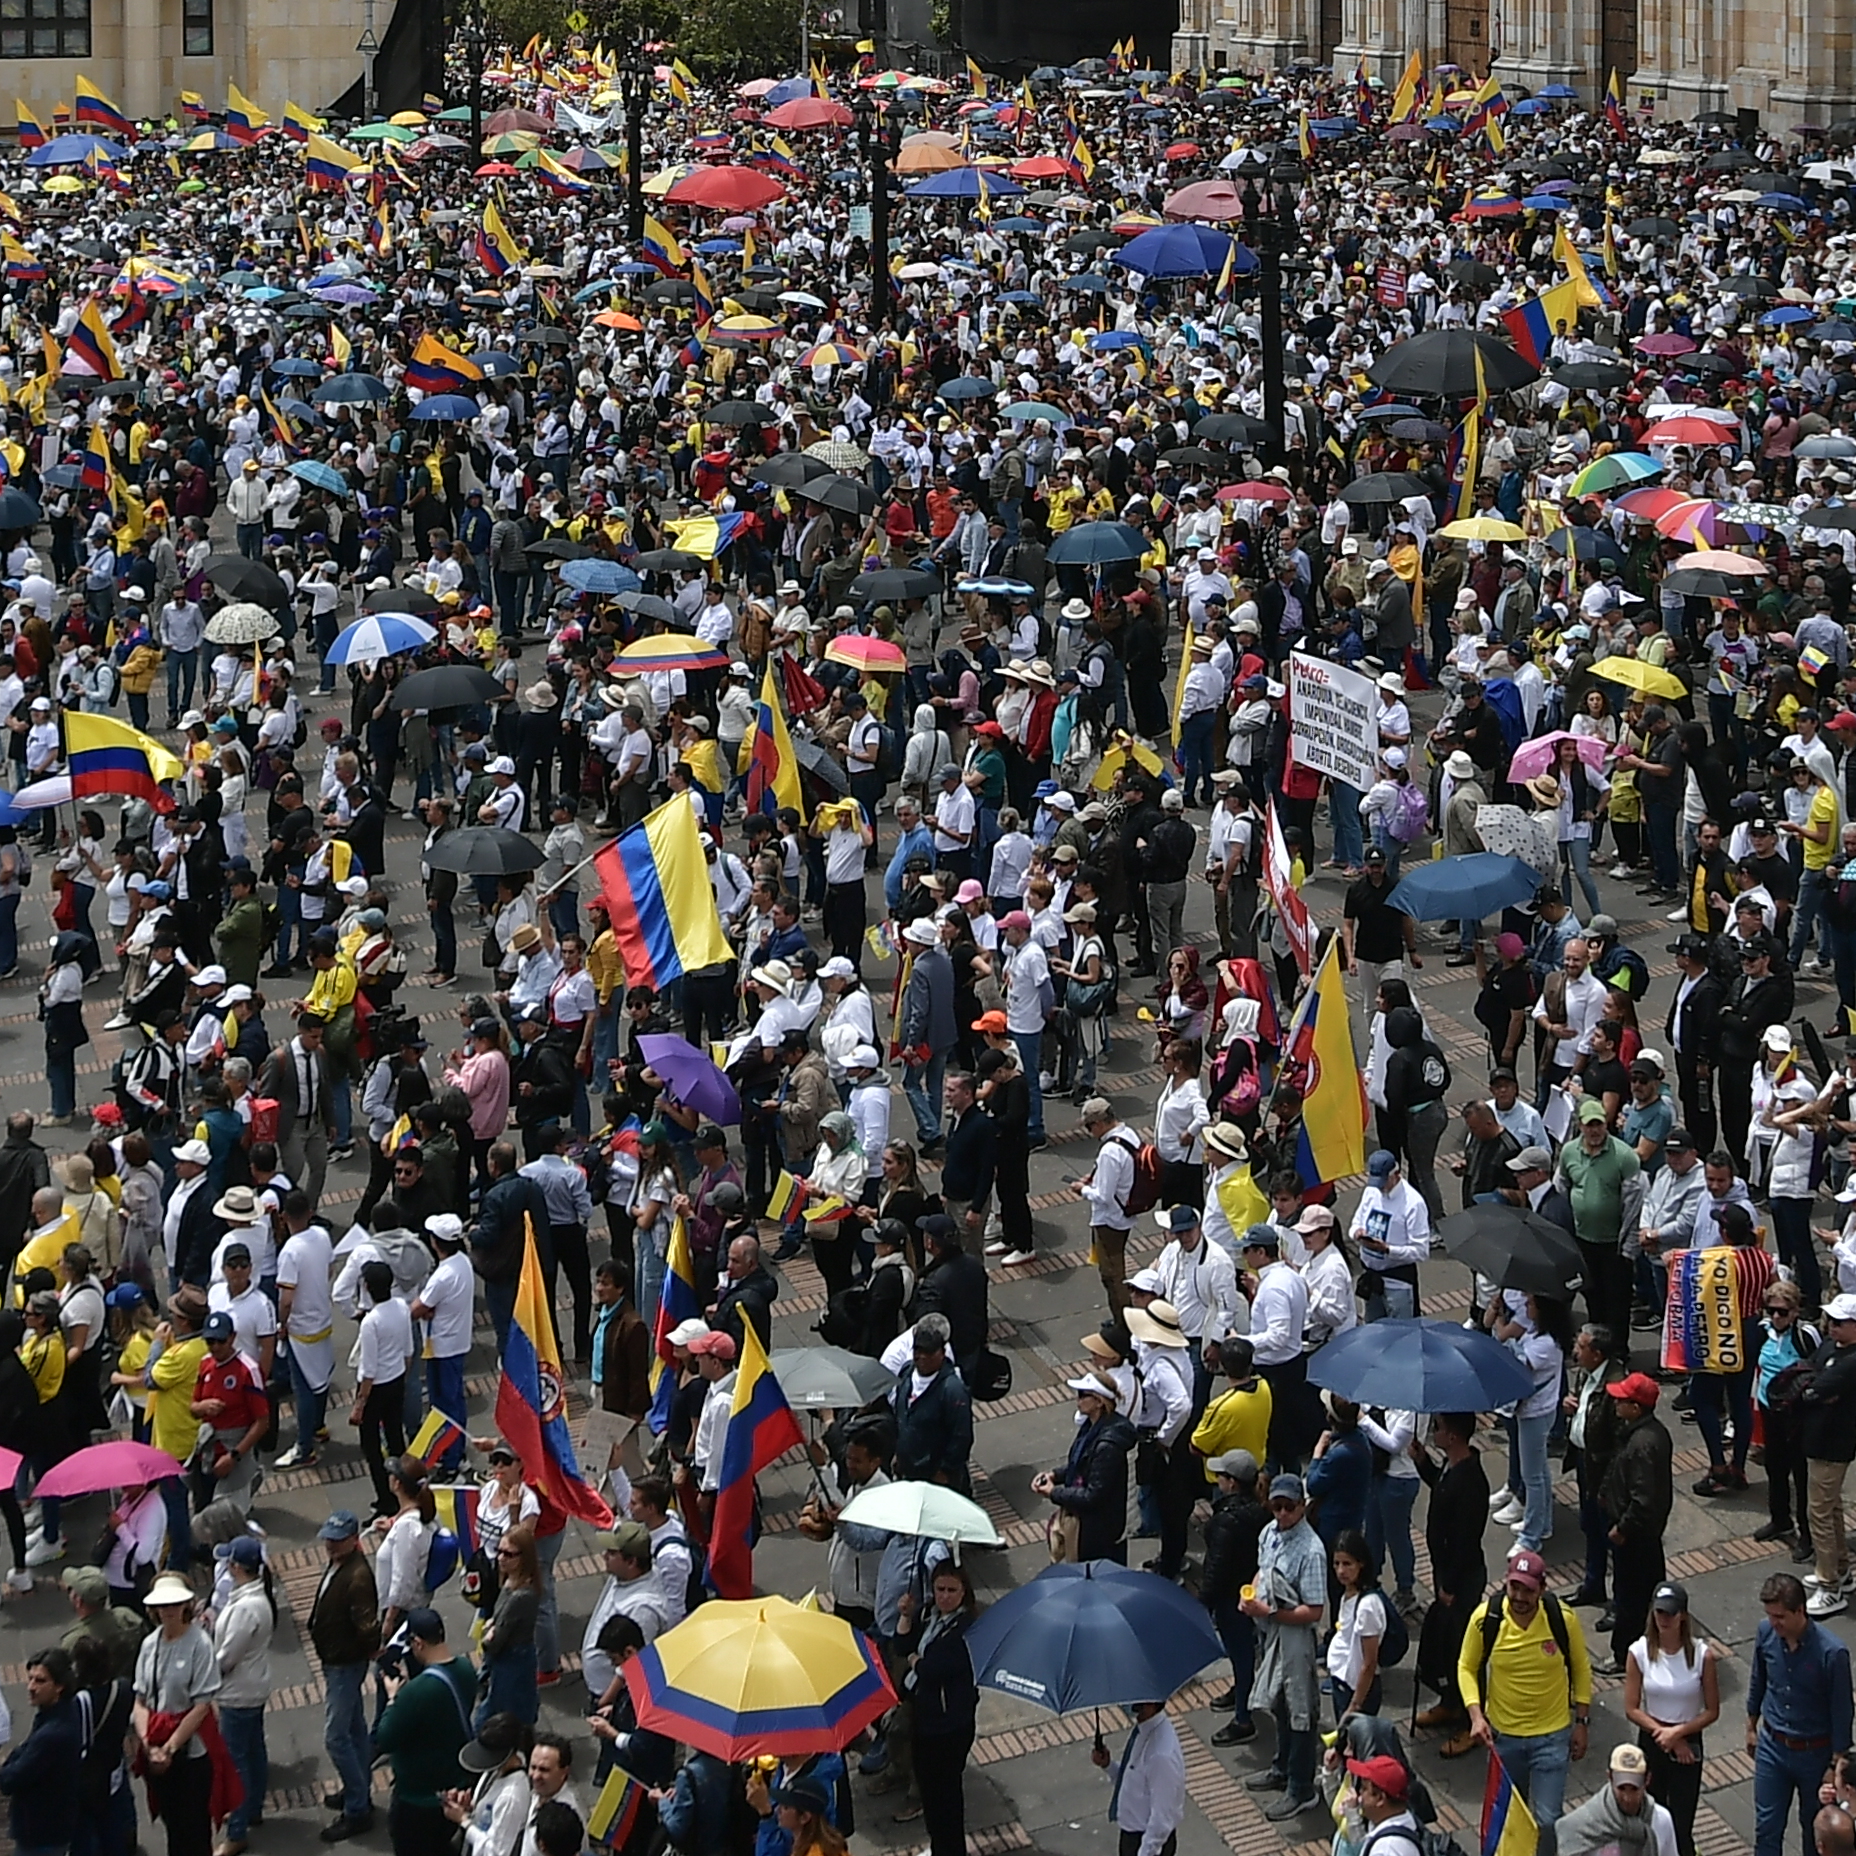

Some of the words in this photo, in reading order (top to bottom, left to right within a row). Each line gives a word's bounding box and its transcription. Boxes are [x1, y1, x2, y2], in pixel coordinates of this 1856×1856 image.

[1713, 1255, 1727, 1279] YO
[1715, 1286, 1732, 1329] DIGO
[1690, 1303, 1711, 1359] PETRO
[1717, 1333, 1738, 1366] NO
